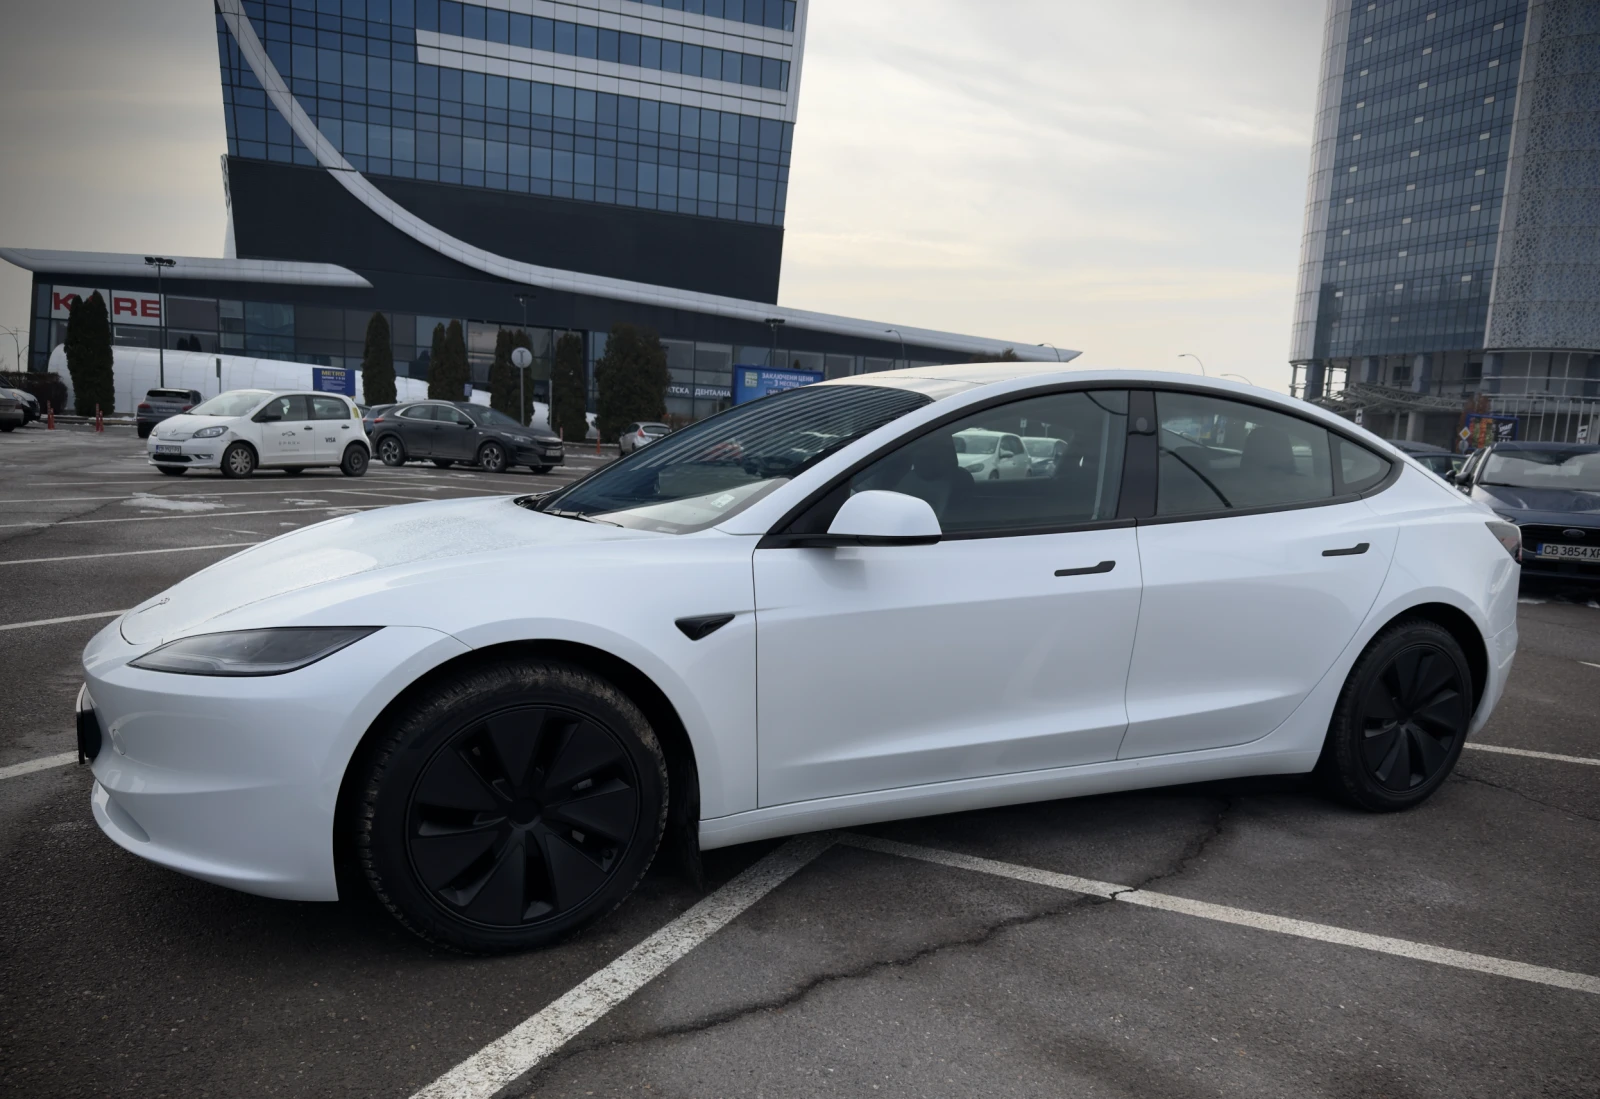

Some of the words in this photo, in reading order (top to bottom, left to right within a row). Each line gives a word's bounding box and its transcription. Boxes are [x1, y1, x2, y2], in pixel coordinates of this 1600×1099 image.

[53, 292, 160, 318] KRE
[761, 372, 798, 381] ЗАКЛЮЧЕНИ
[694, 388, 732, 398] ДЕНТАЛНА
[1543, 544, 1559, 555] CB
[1560, 546, 1588, 558] 3854
